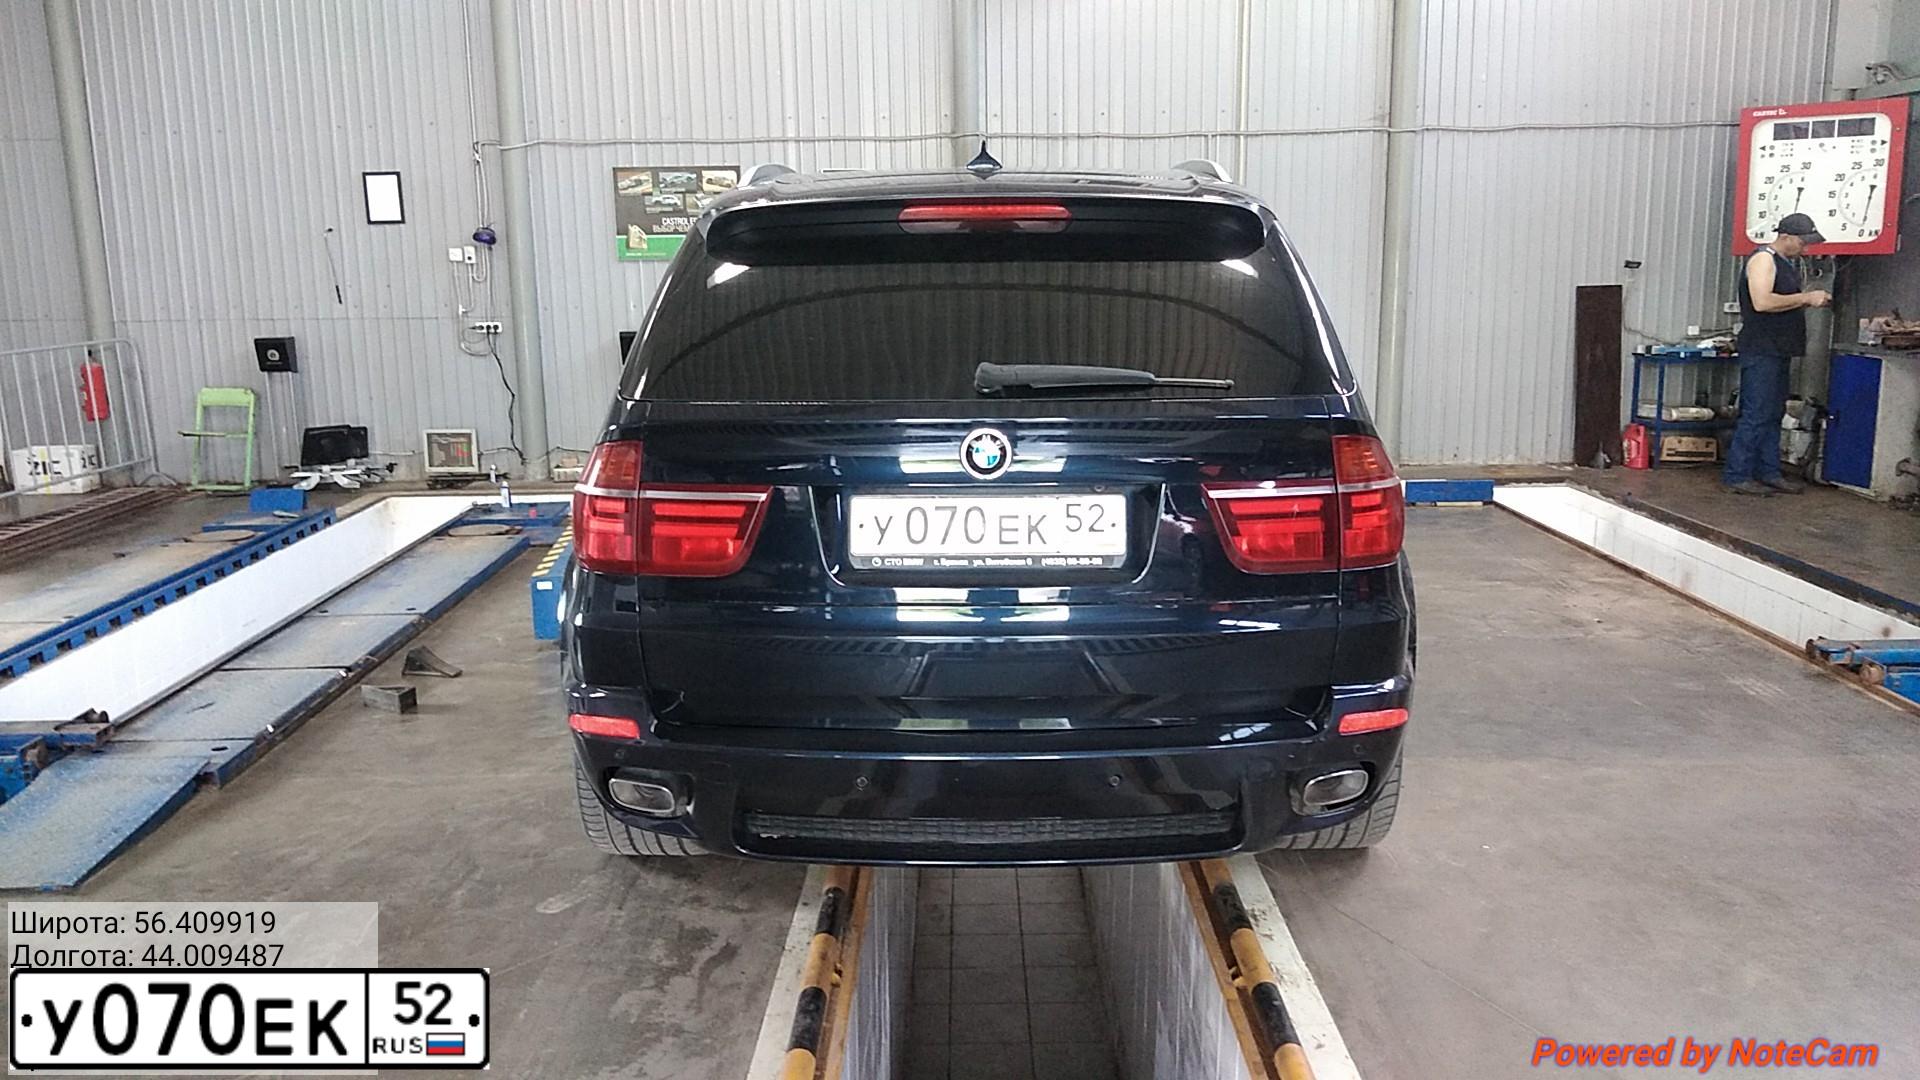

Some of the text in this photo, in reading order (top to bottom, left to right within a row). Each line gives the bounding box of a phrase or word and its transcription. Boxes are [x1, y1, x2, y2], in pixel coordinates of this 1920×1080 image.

[1801, 162, 1812, 170] 30
[1851, 162, 1863, 170] 25
[1873, 158, 1885, 167] 30
[1764, 176, 1775, 184] 20
[1834, 173, 1846, 181] 20
[1828, 190, 1837, 198] 15
[1828, 209, 1837, 217] 10
[662, 217, 689, 226] CASTROL
[1841, 223, 1848, 231] 5
[1065, 504, 1105, 532] 52
